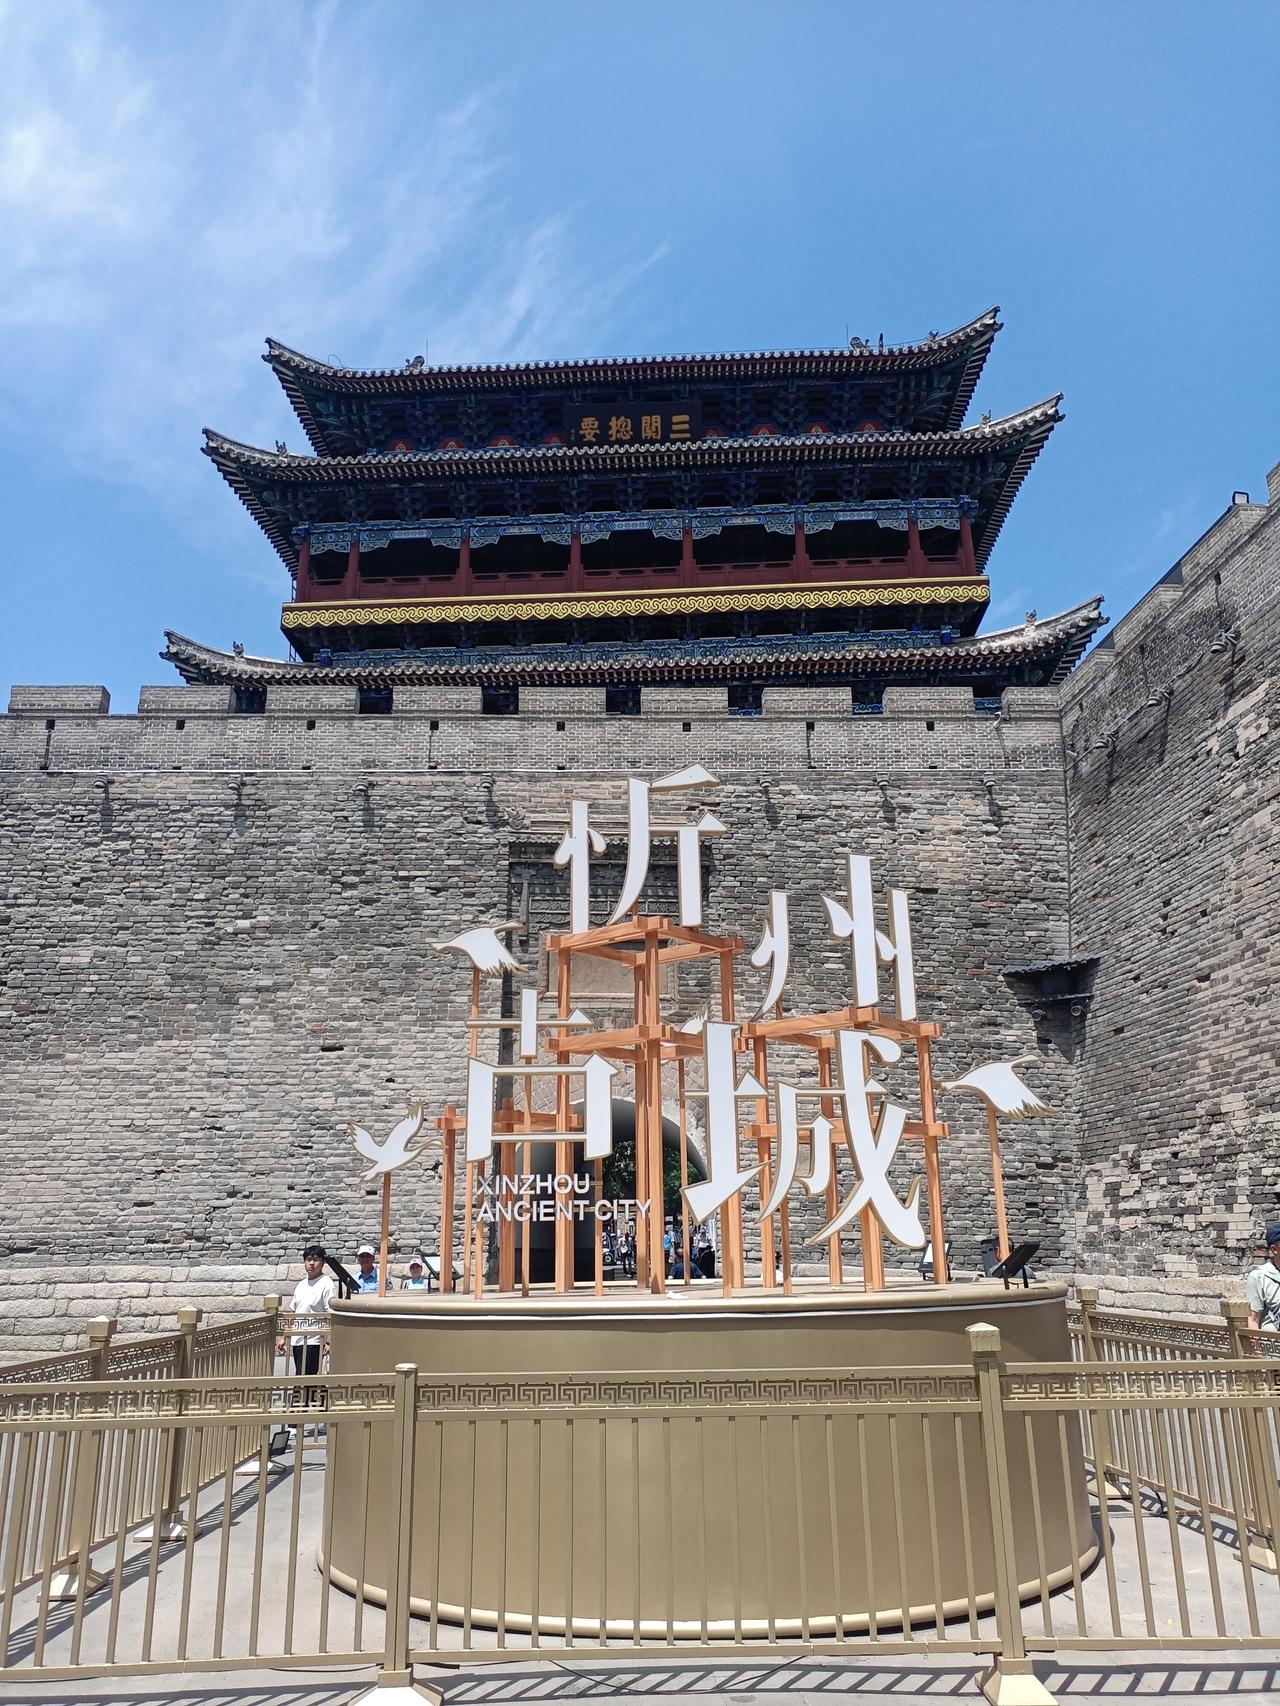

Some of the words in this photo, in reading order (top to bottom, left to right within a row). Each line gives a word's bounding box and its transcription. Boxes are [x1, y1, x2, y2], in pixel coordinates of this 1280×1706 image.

[476, 1173, 590, 1195] XINZHOU
[476, 1200, 590, 1222] ANCIENT
[594, 1198, 652, 1221] CITY
